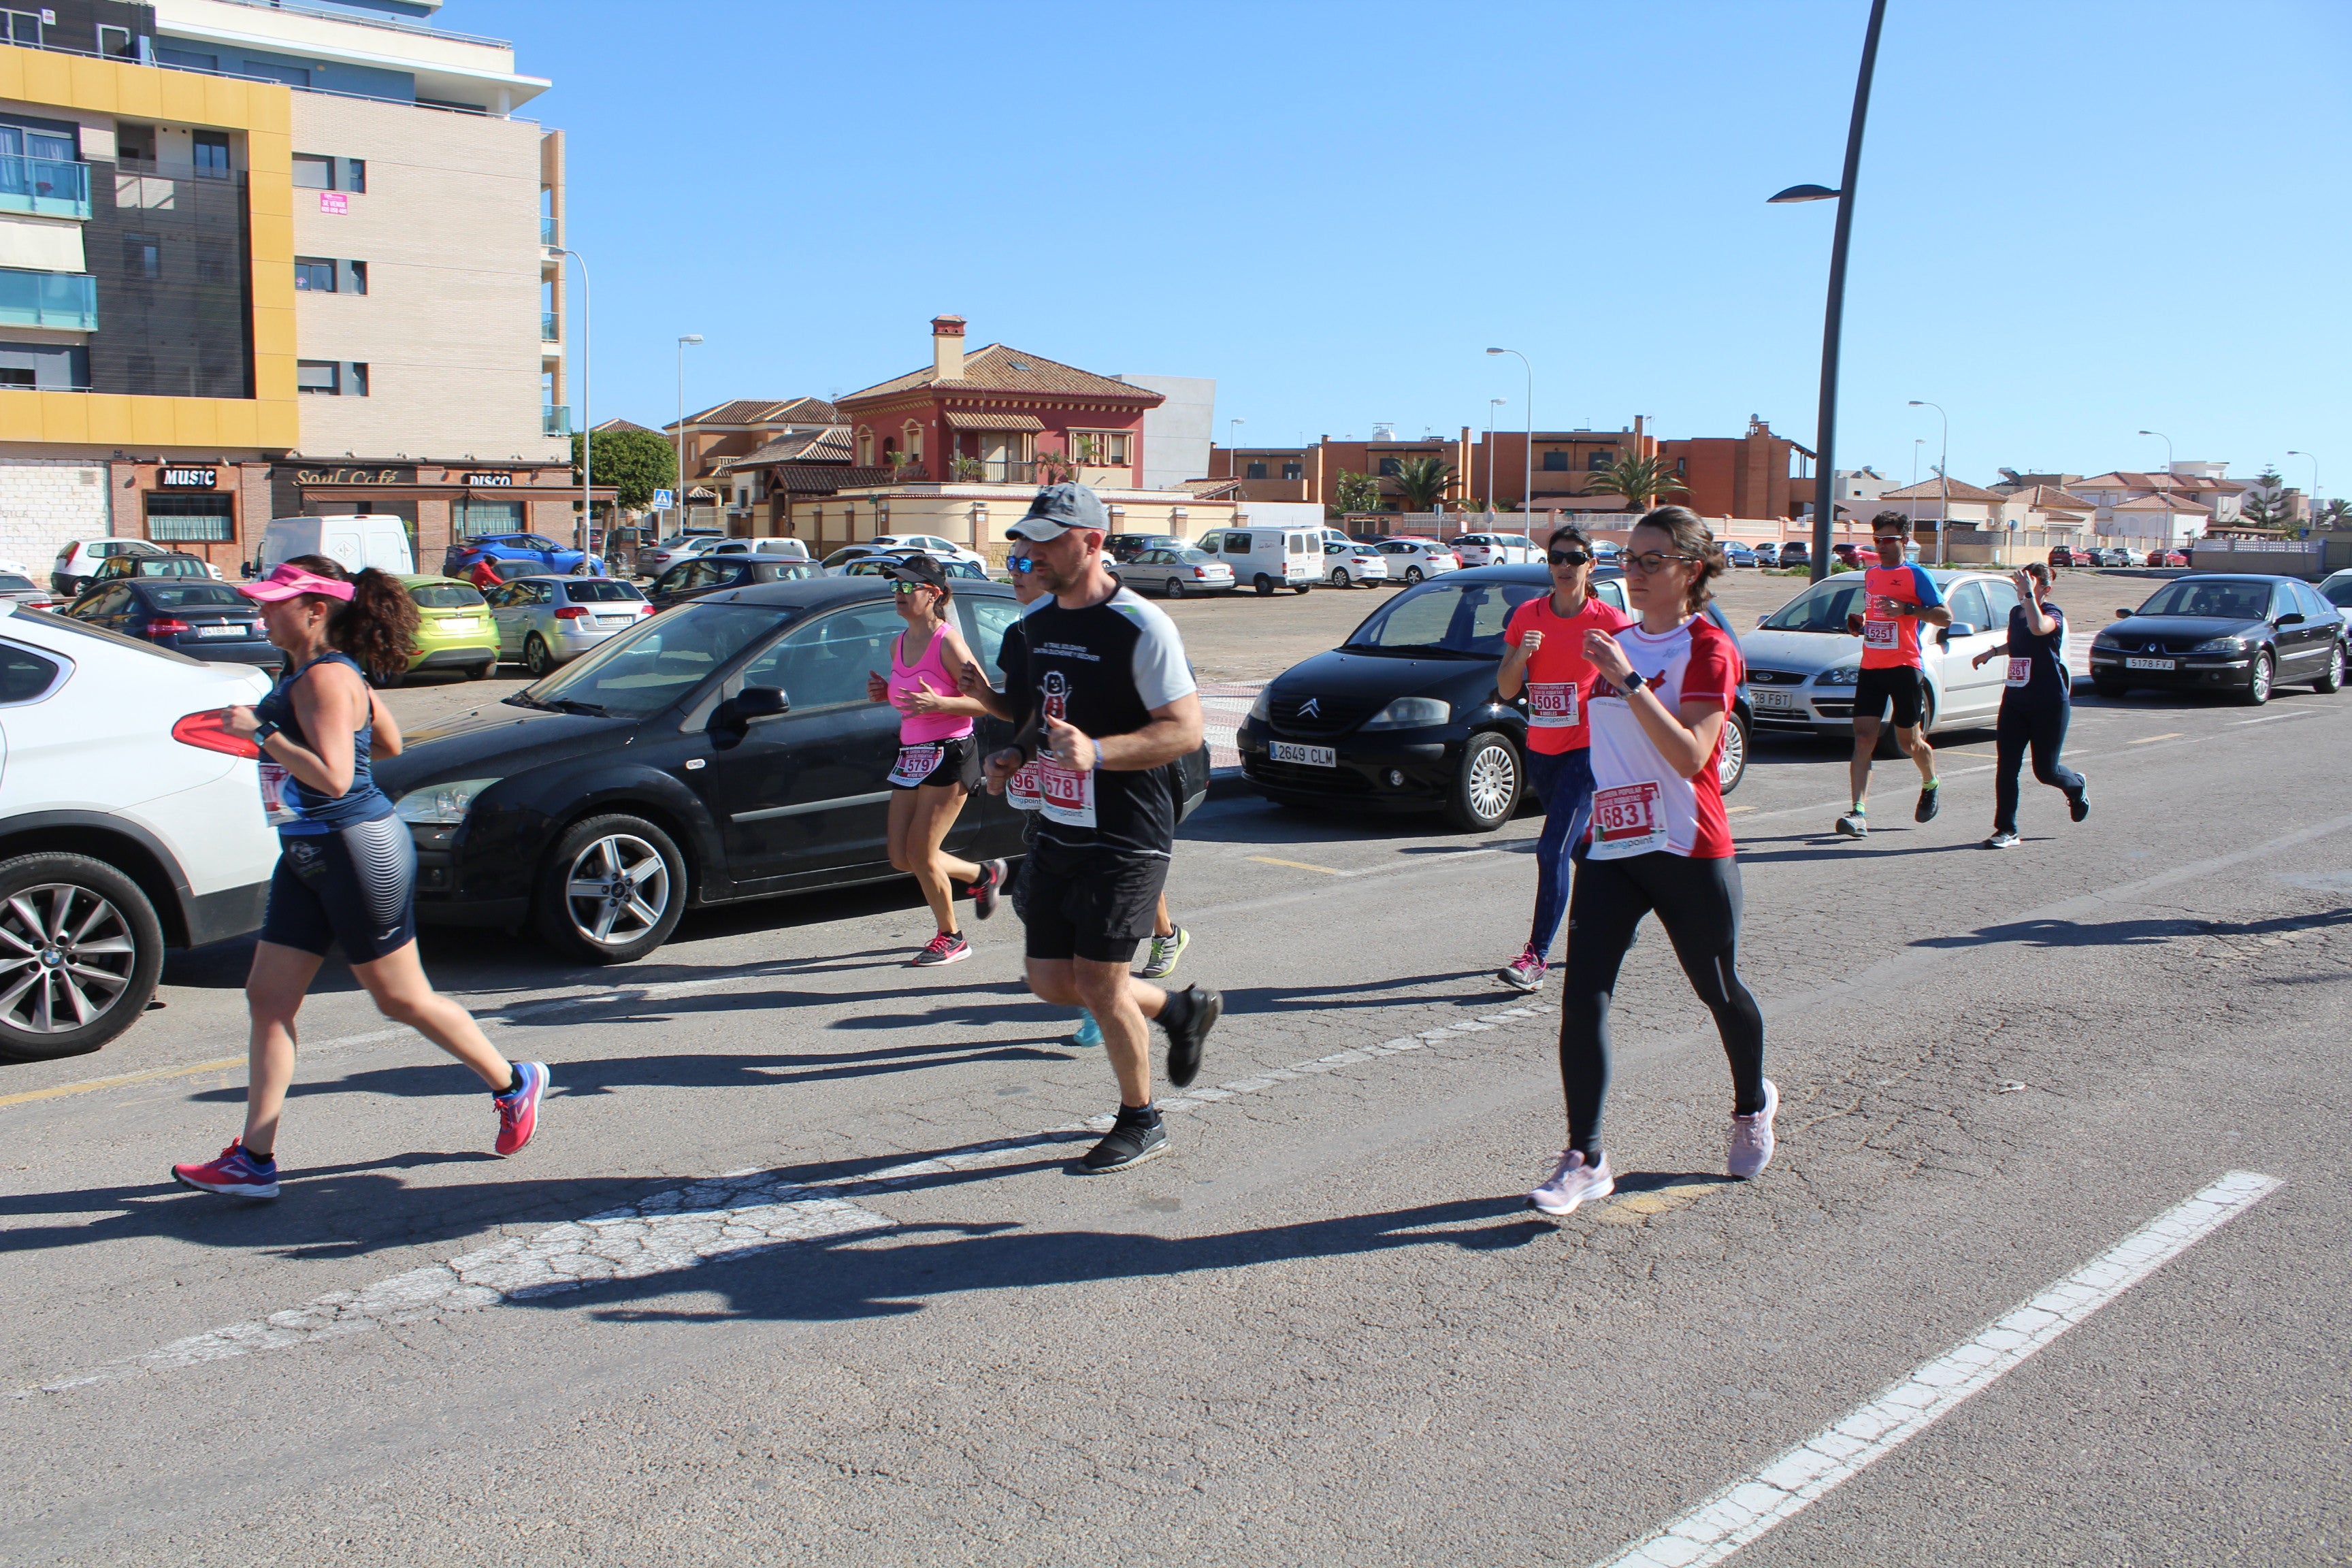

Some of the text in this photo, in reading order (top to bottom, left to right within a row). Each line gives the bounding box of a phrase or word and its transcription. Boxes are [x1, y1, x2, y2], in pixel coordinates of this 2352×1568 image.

[163, 470, 216, 486] MUSIC
[291, 469, 398, 486] Soul Café
[470, 475, 511, 485] DISCO
[1870, 630, 1886, 638] 525
[2132, 659, 2153, 668] 5178
[1537, 696, 1561, 709] 508
[1768, 694, 1788, 706] FBT
[1279, 745, 1333, 764] 2649 CLM
[907, 759, 930, 772] 579
[1045, 775, 1073, 798] 678
[1604, 804, 1639, 829] 683
